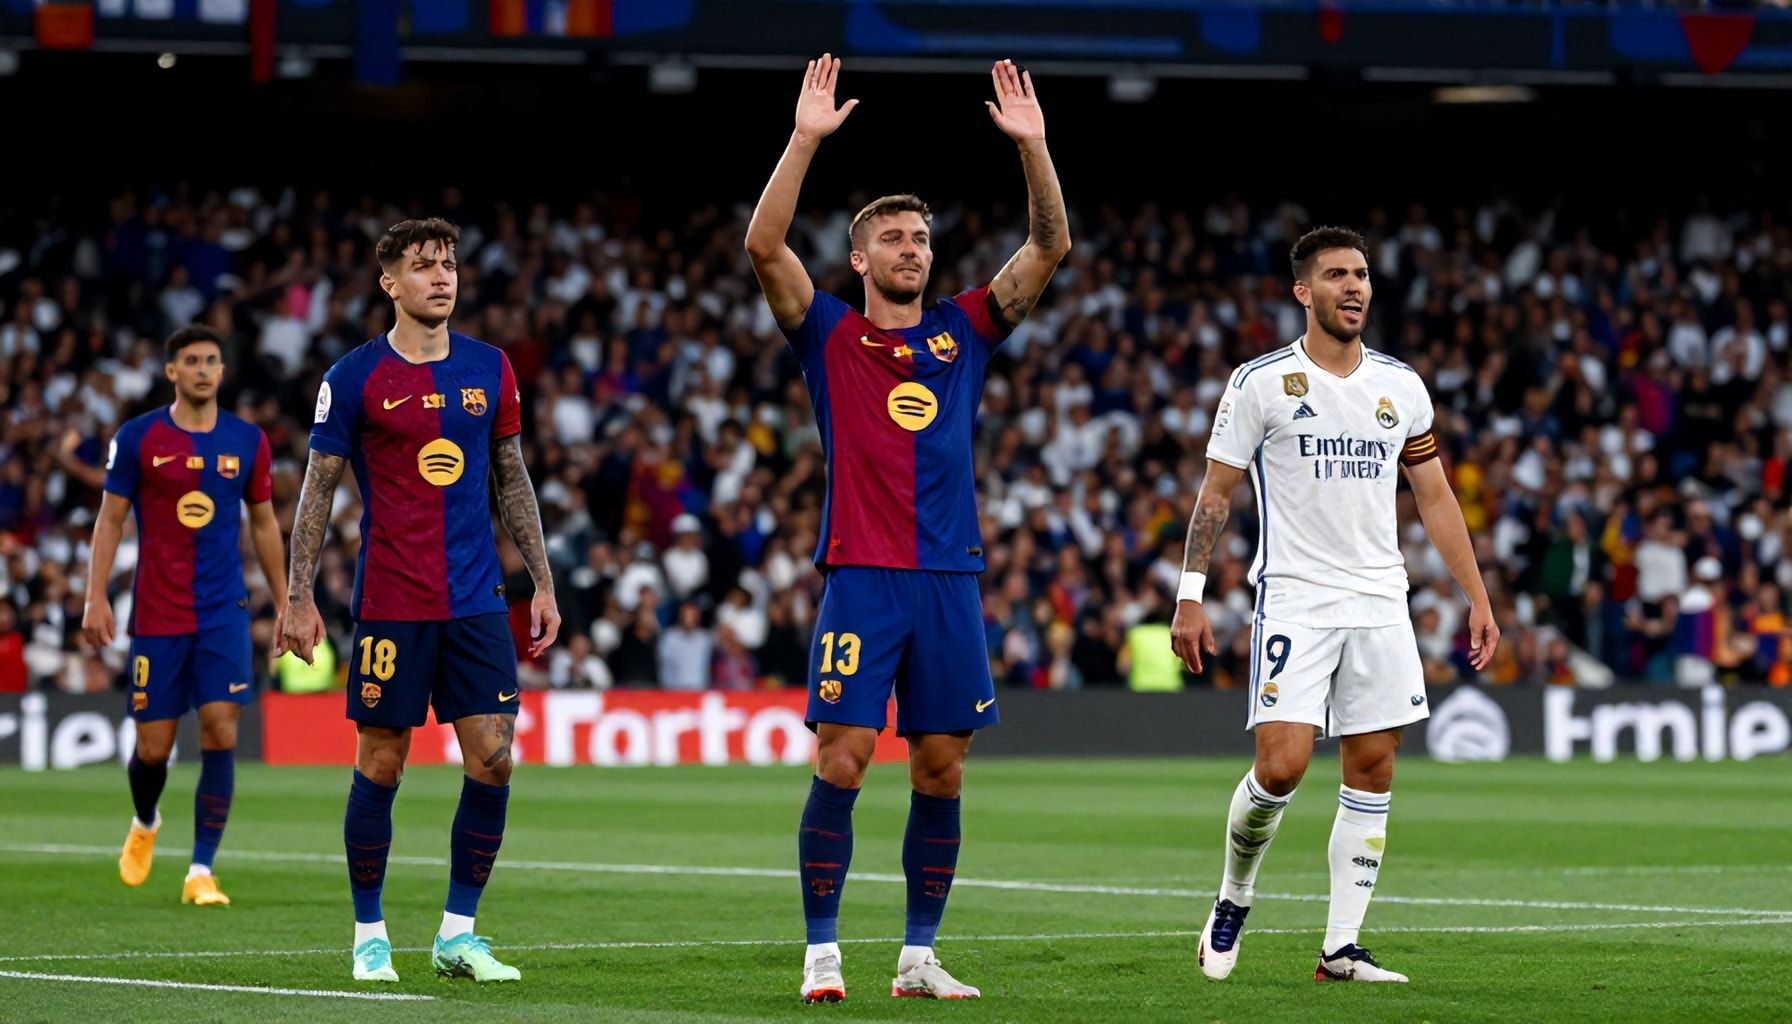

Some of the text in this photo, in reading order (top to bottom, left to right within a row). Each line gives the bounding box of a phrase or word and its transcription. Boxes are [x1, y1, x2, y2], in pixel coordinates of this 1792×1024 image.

[360, 636, 397, 681] 18
[820, 632, 861, 675] 13
[1266, 634, 1291, 680] 9
